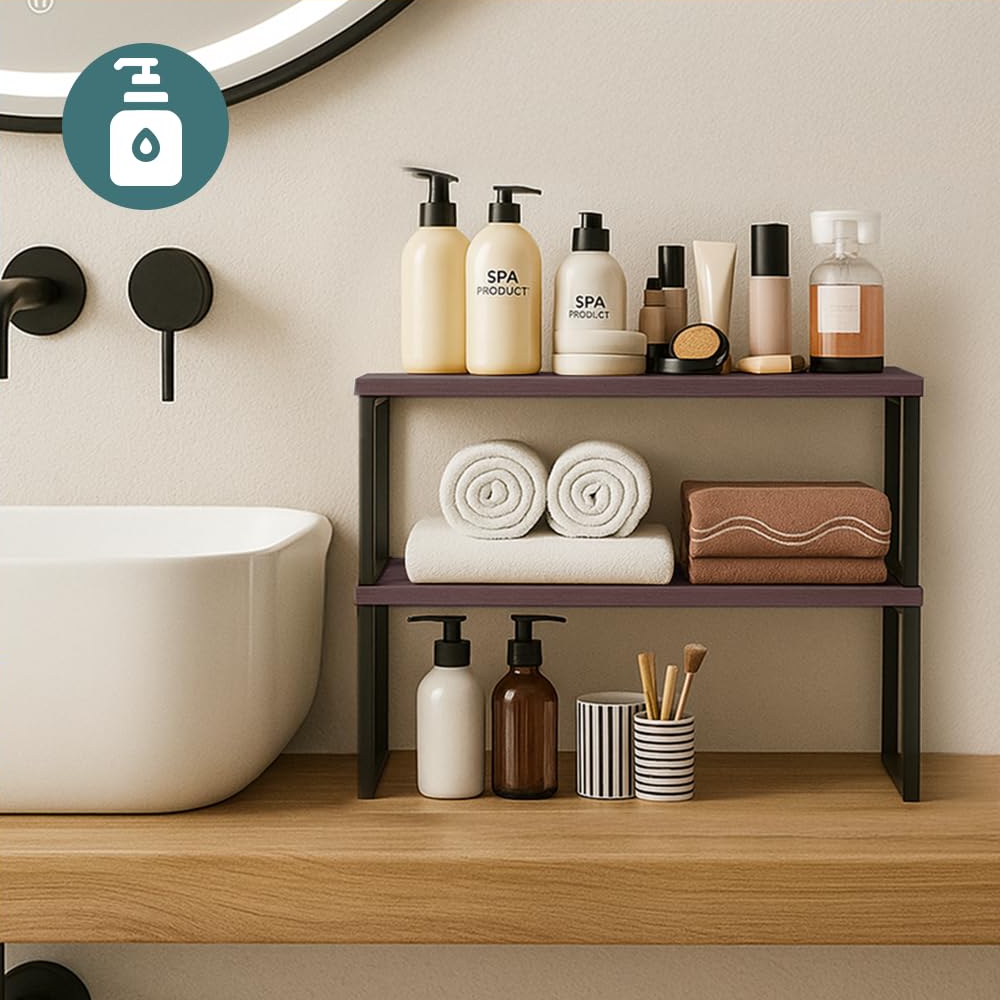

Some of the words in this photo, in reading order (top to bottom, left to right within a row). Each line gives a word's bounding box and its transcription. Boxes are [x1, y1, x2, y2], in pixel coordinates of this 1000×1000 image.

[487, 270, 519, 284] SPA
[477, 286, 528, 296] PRODUCT
[575, 295, 606, 308] SPA
